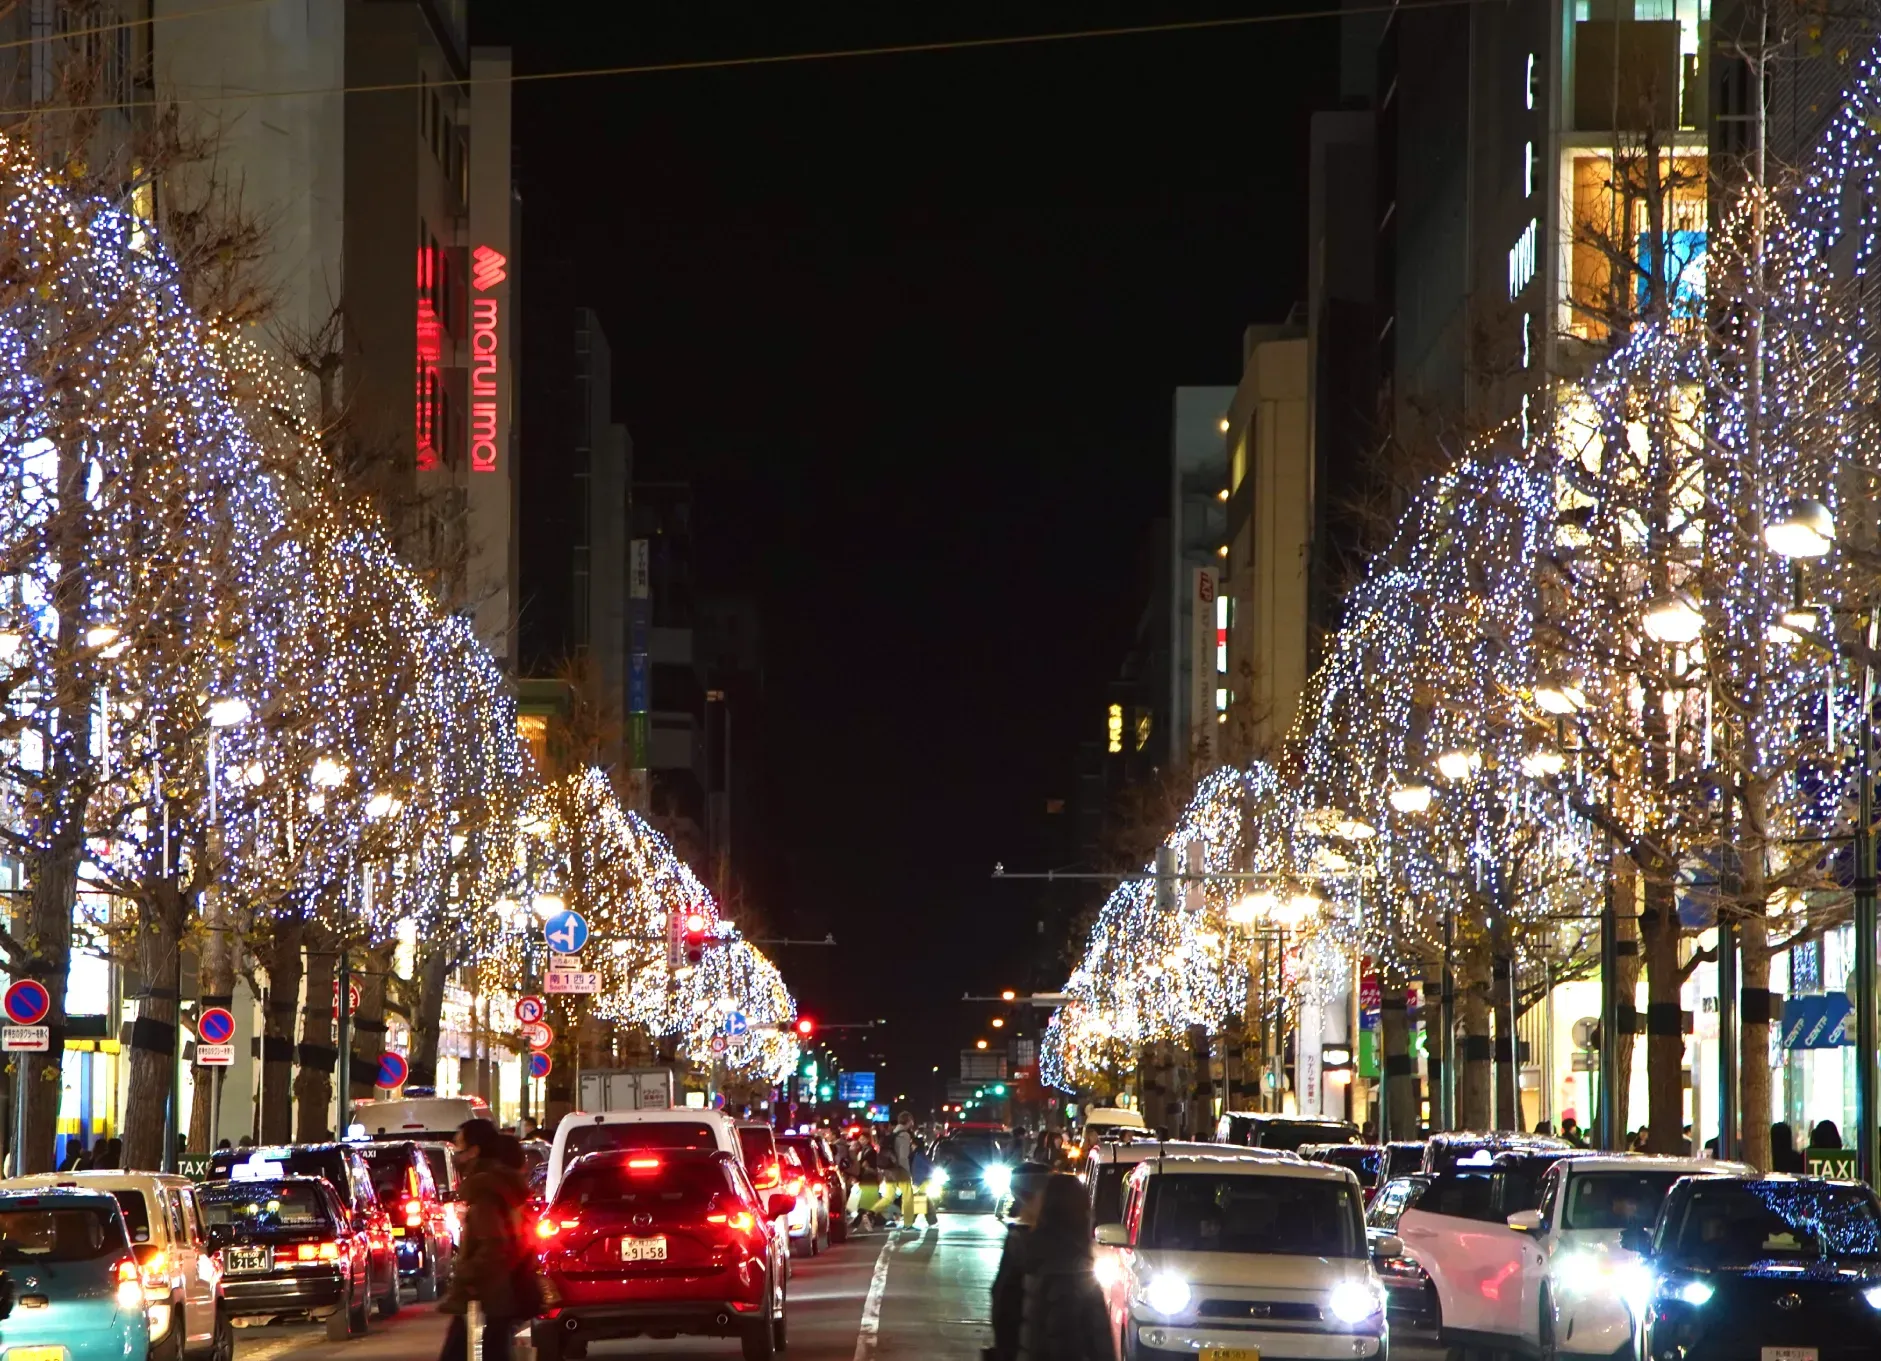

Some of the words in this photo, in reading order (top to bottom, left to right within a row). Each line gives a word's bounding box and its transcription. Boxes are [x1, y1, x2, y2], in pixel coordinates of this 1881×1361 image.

[472, 299, 498, 396] marui
[471, 402, 498, 472] imai
[1809, 1159, 1857, 1180] TAXI
[237, 1257, 266, 1269] 21-94
[631, 1247, 664, 1259] 91-58
